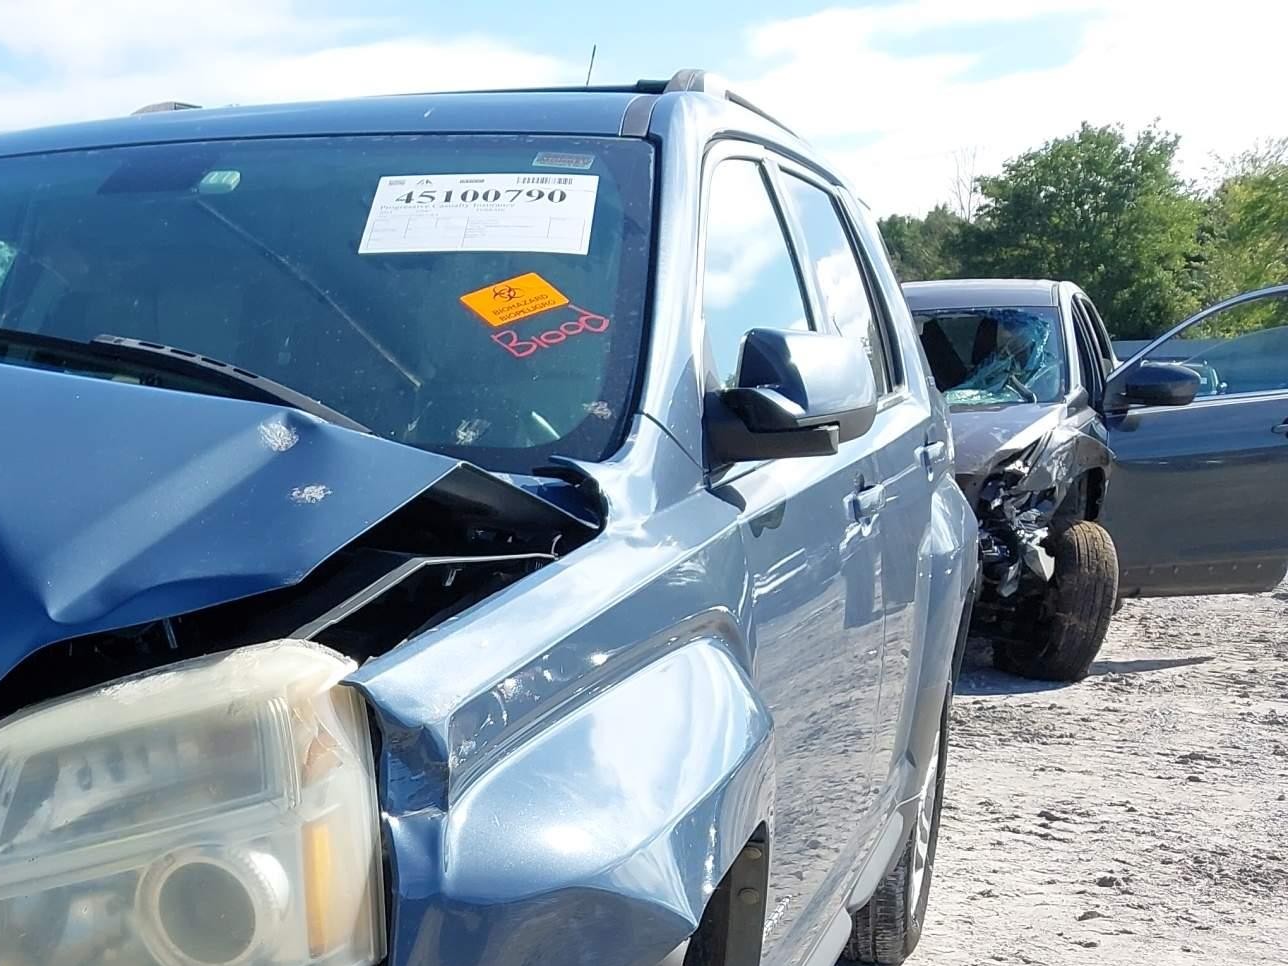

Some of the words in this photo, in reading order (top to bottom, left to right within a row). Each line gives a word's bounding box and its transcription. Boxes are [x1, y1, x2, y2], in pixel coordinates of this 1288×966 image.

[395, 189, 566, 204] 45100790
[492, 294, 548, 316] BIOHAZARD
[499, 300, 556, 322] BIOPELIGRO
